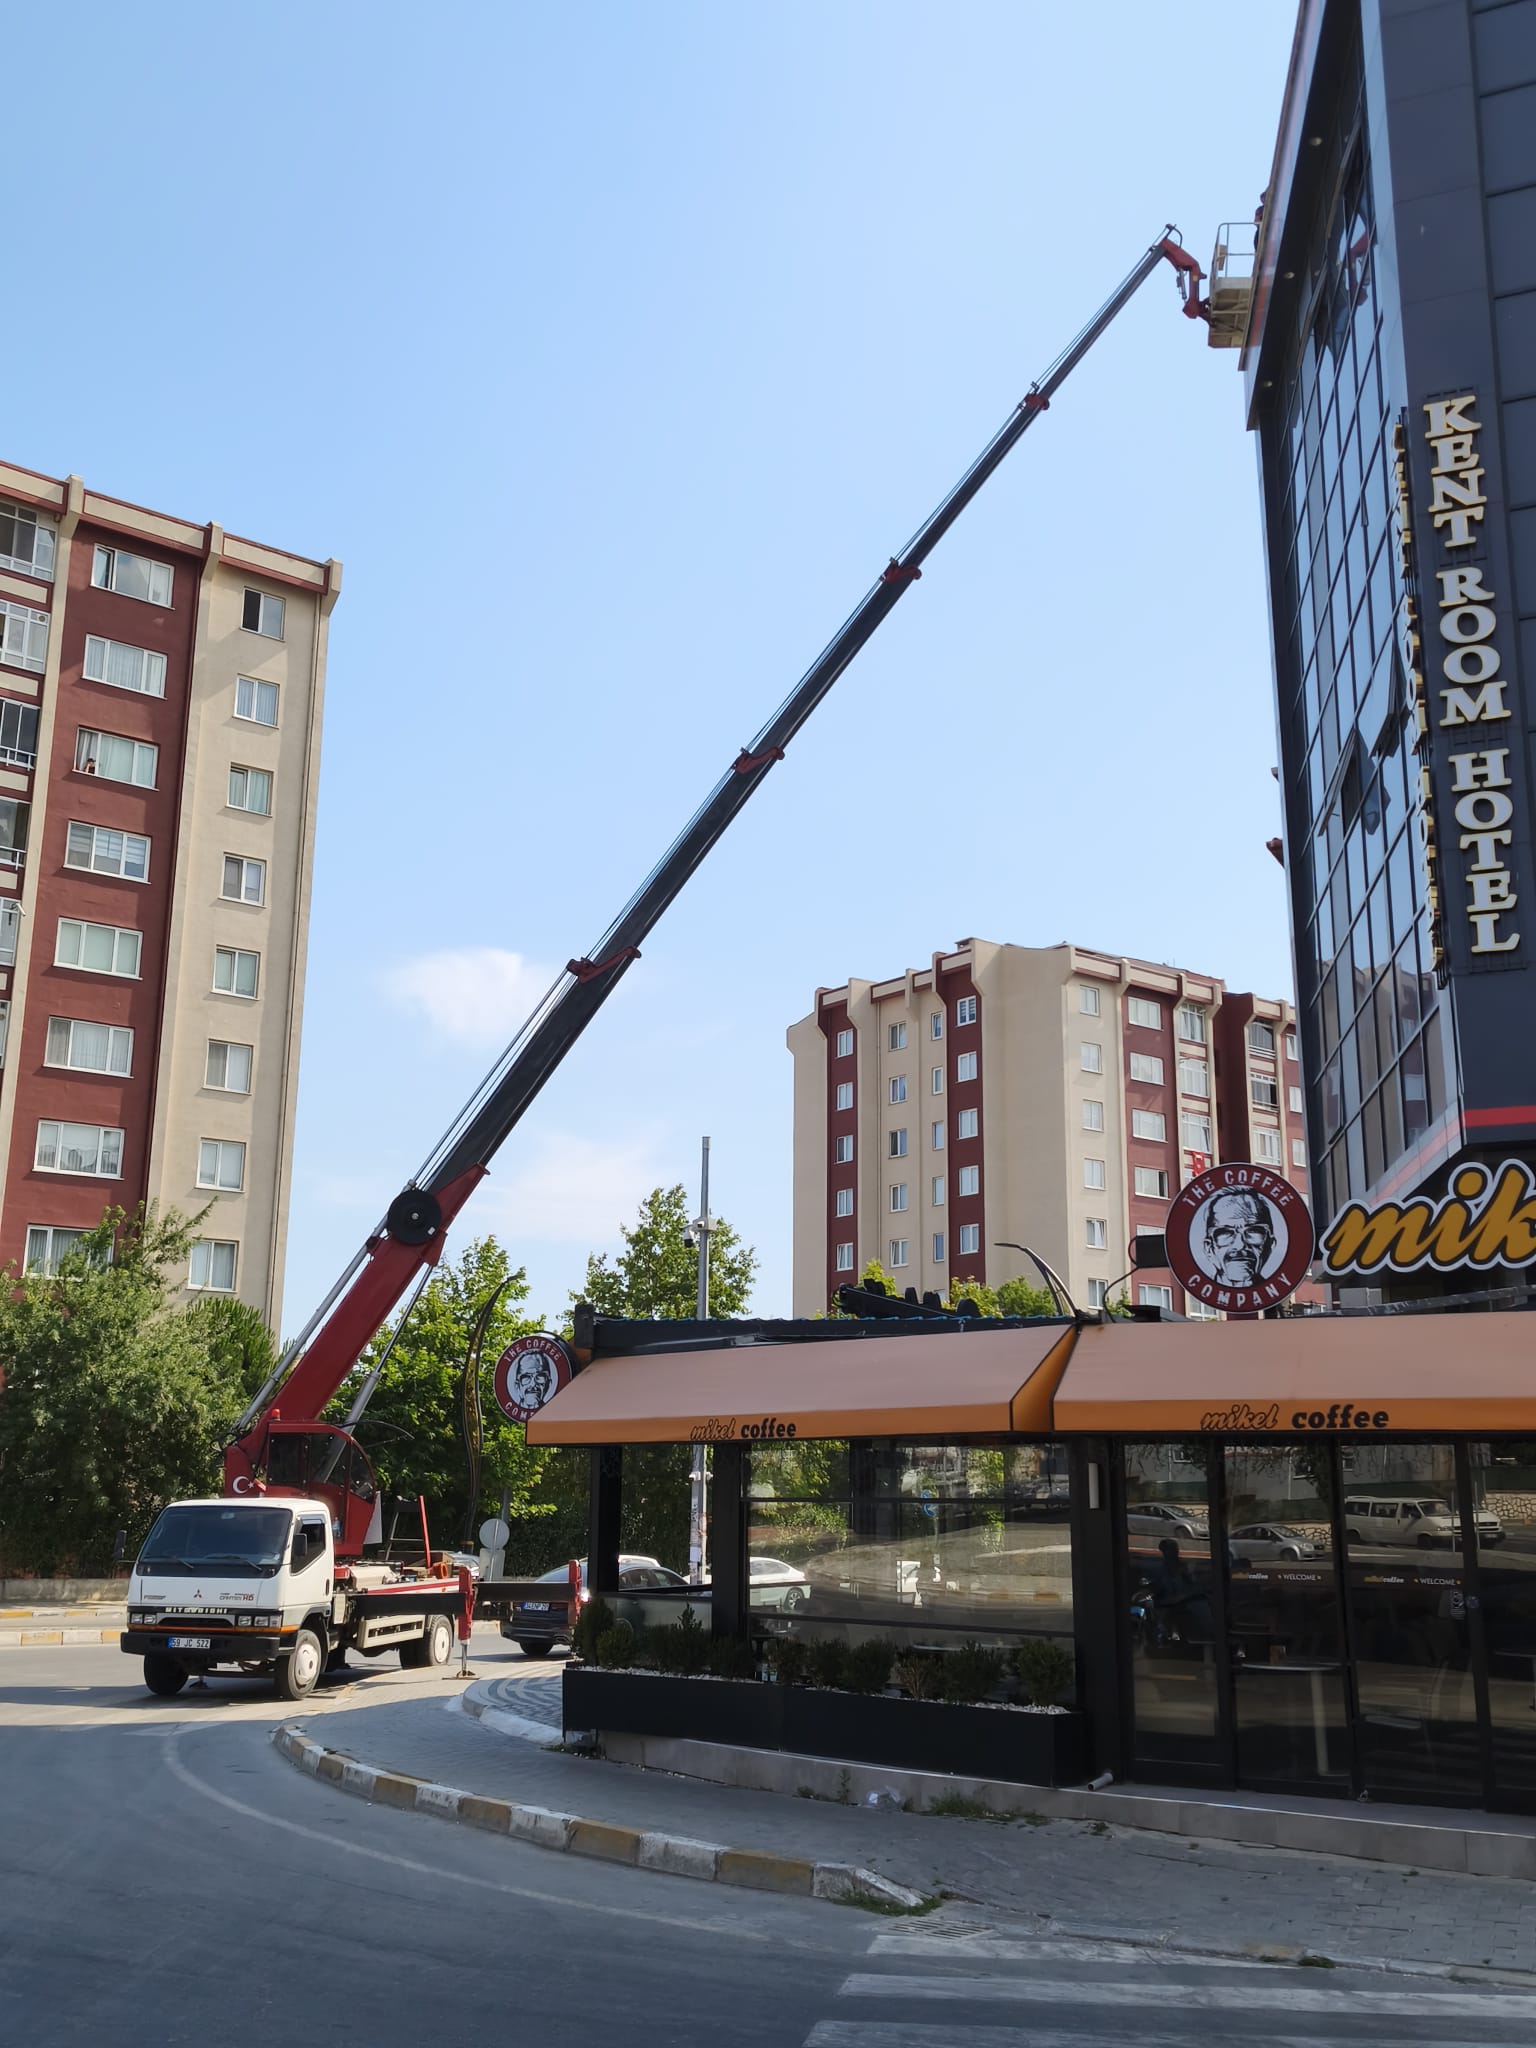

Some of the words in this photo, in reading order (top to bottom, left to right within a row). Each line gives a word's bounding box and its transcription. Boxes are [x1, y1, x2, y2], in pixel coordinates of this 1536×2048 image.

[1423, 395, 1487, 548] KENT
[1436, 566, 1512, 726] ROOM
[1448, 748, 1520, 953] HOTEL
[1188, 1273, 1292, 1307] COMPANY
[690, 1417, 737, 1440] mikel
[741, 1417, 797, 1438] coffee
[1200, 1403, 1280, 1430] mikel
[1291, 1404, 1389, 1429] coffee
[1283, 1573, 1316, 1581] WELCOME
[1419, 1577, 1456, 1585] WELCOME
[183, 1639, 193, 1648] JC
[196, 1639, 209, 1648] 522
